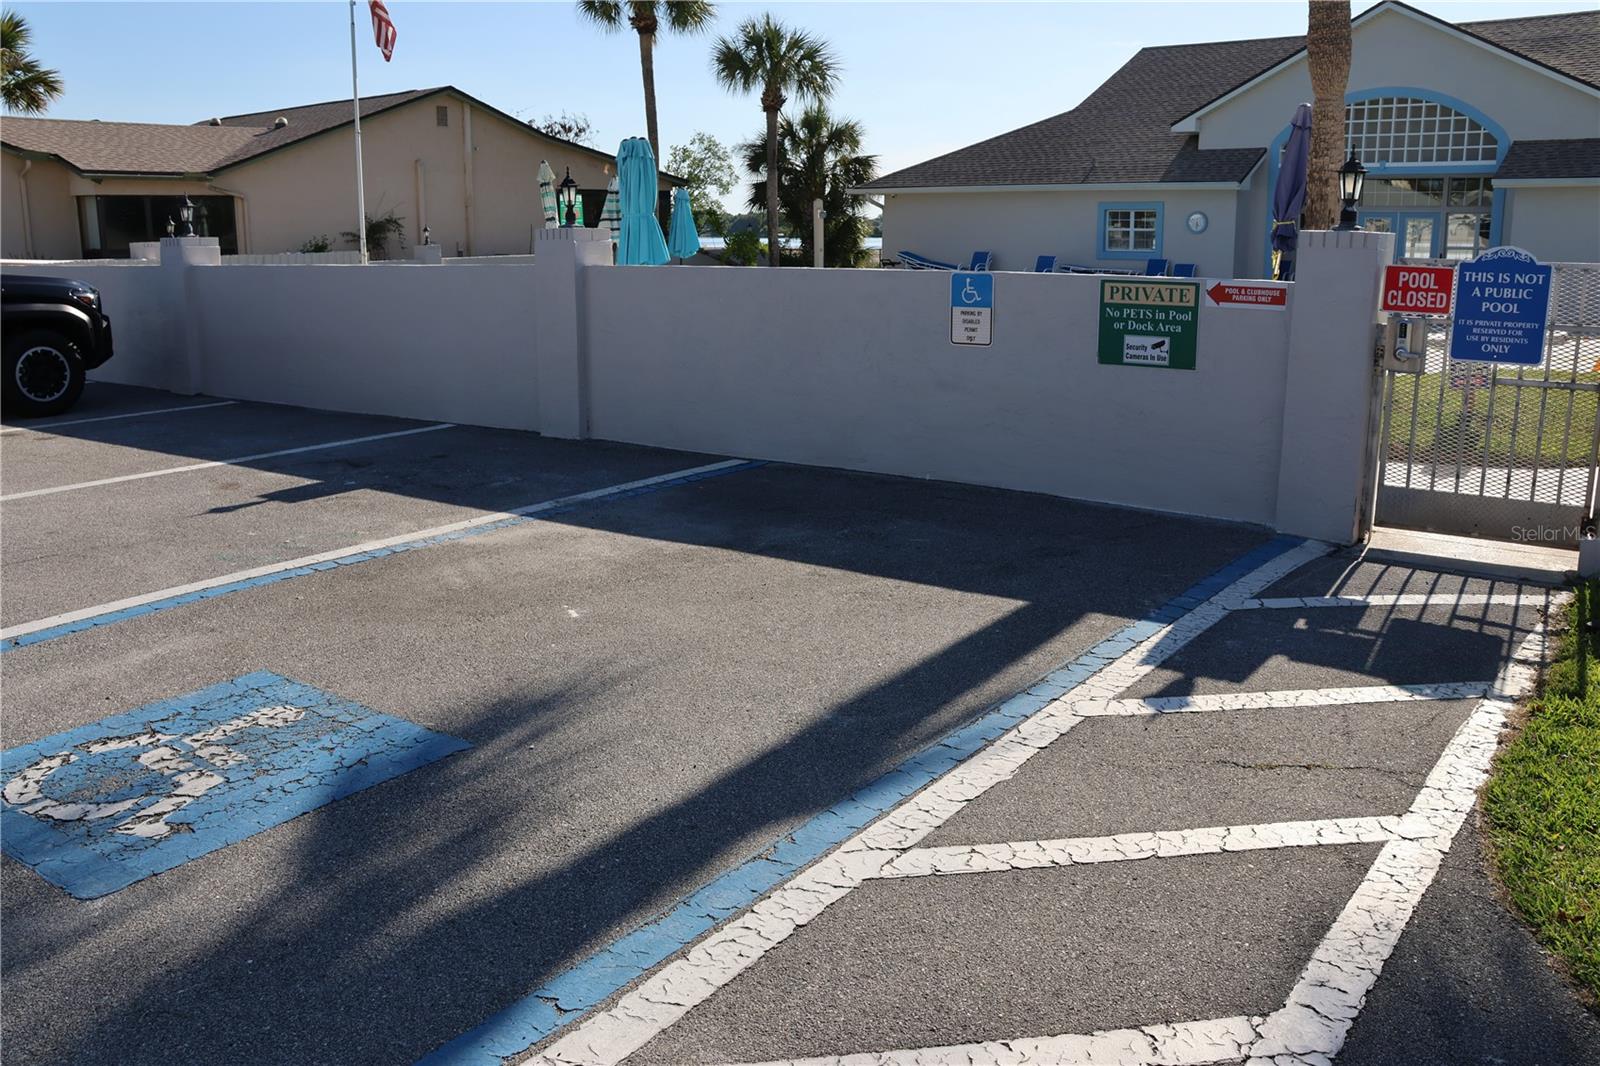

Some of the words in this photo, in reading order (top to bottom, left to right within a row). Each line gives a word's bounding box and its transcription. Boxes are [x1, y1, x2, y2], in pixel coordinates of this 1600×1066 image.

[1398, 271, 1439, 289] POOL
[1463, 271, 1494, 284] THIS
[1498, 272, 1511, 284] IS
[1514, 273, 1545, 285] NOT
[1110, 285, 1192, 304] PRIVATE
[1225, 287, 1240, 295] POOL
[1246, 288, 1281, 297] CLUBHOUSE
[1471, 287, 1480, 296] A
[1485, 287, 1533, 299] PUBLIC
[1232, 294, 1257, 302] PARKING
[1257, 295, 1272, 303] ONLY
[1387, 289, 1447, 308] CLOSED
[1481, 302, 1521, 314] POOL
[1105, 307, 1120, 318] No
[1122, 308, 1153, 320] PETS
[1155, 309, 1166, 321] in
[1168, 310, 1193, 321] Pool
[1113, 322, 1126, 330] or
[1127, 320, 1155, 332] Dock
[1156, 323, 1183, 333] Area
[1474, 320, 1502, 328] PRIVATE
[1503, 321, 1540, 329] PROPERTY
[1472, 327, 1507, 335] RESERVED
[1490, 336, 1529, 345] RESIDENTS
[1126, 343, 1148, 353] Security
[1481, 343, 1511, 353] ONLY
[1125, 352, 1149, 361] Cameras
[1156, 354, 1168, 363] Use
